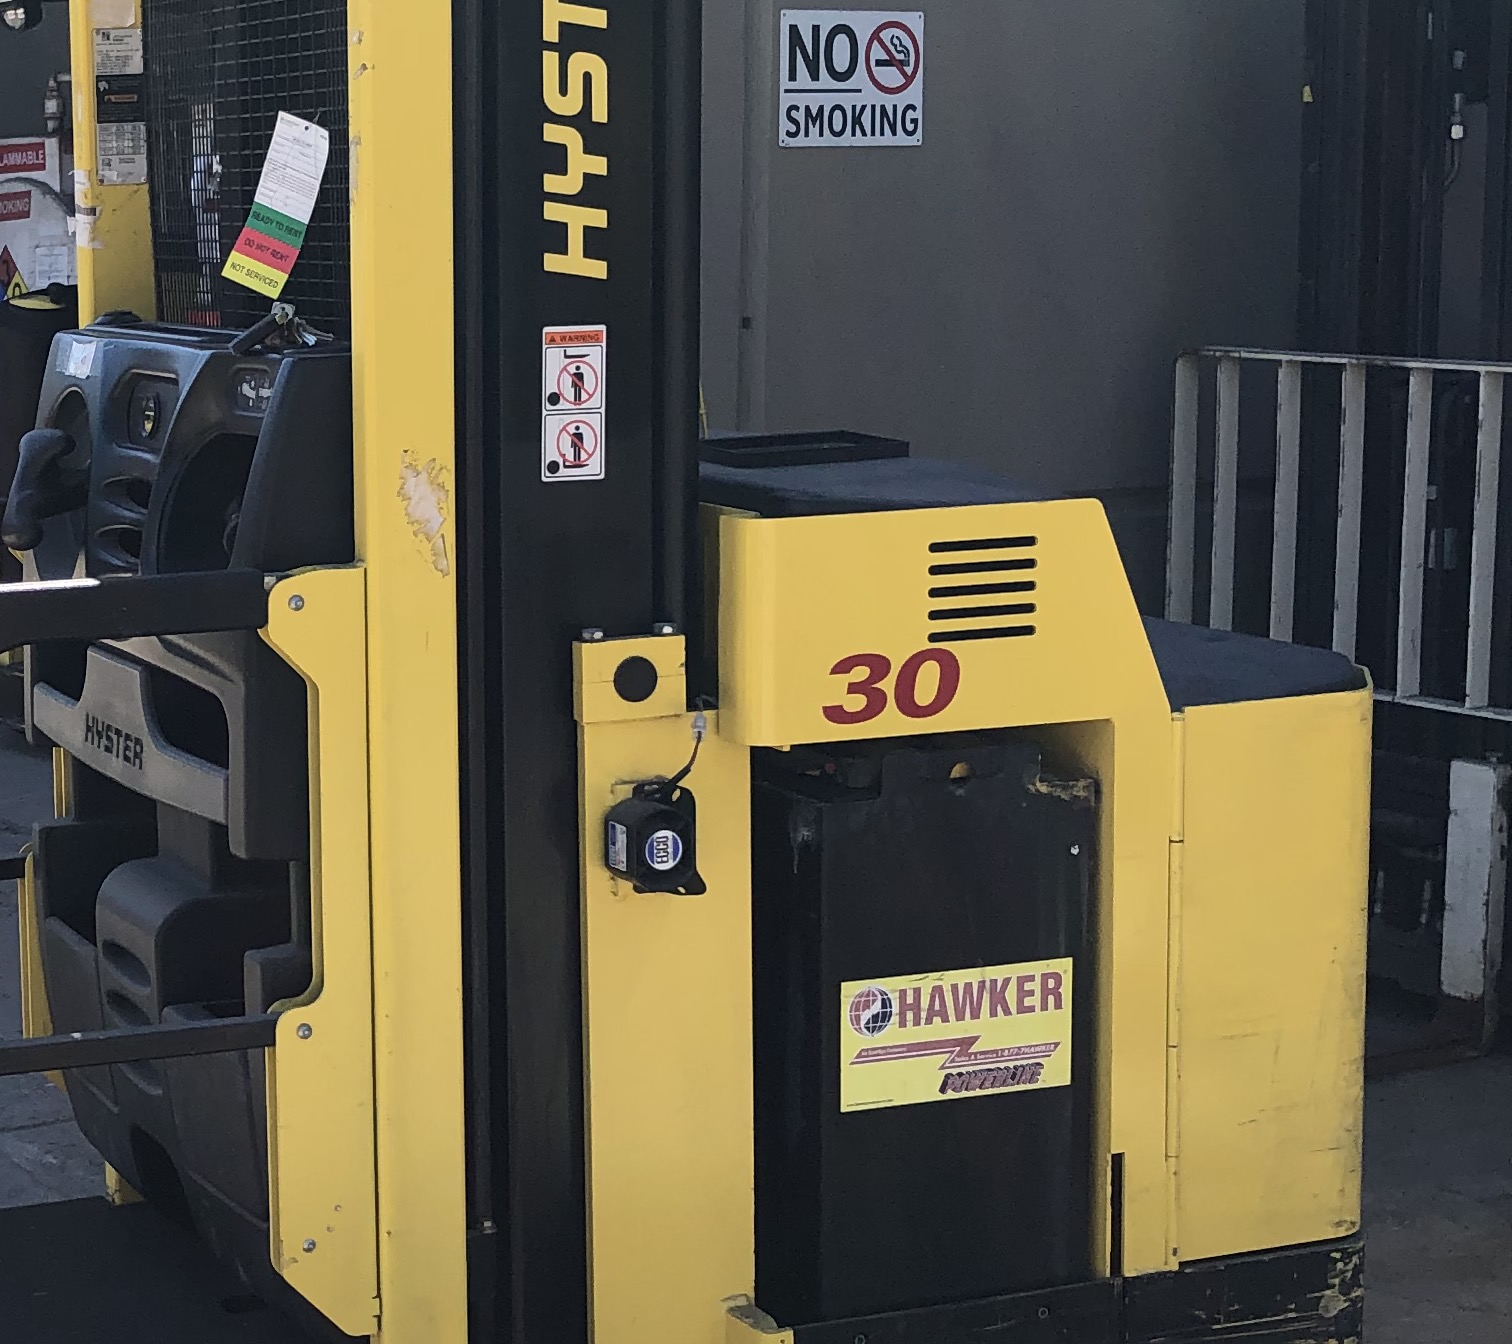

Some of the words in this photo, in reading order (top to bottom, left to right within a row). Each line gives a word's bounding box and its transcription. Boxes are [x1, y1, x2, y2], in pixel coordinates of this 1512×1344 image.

[788, 23, 859, 83] NO
[785, 103, 919, 139] SMOKING
[252, 210, 275, 225] READY
[284, 224, 304, 240] RENT
[244, 237, 255, 249] DO
[230, 261, 246, 274] NOT
[245, 268, 279, 289] SERVICED
[559, 333, 601, 343] WARNING
[822, 647, 961, 725] 30
[84, 711, 144, 771] HYSTER
[654, 835, 671, 865] ECCO
[898, 971, 1064, 1029] HAWKER
[976, 1052, 997, 1060] Service
[939, 1062, 1045, 1095] POWERLINE
